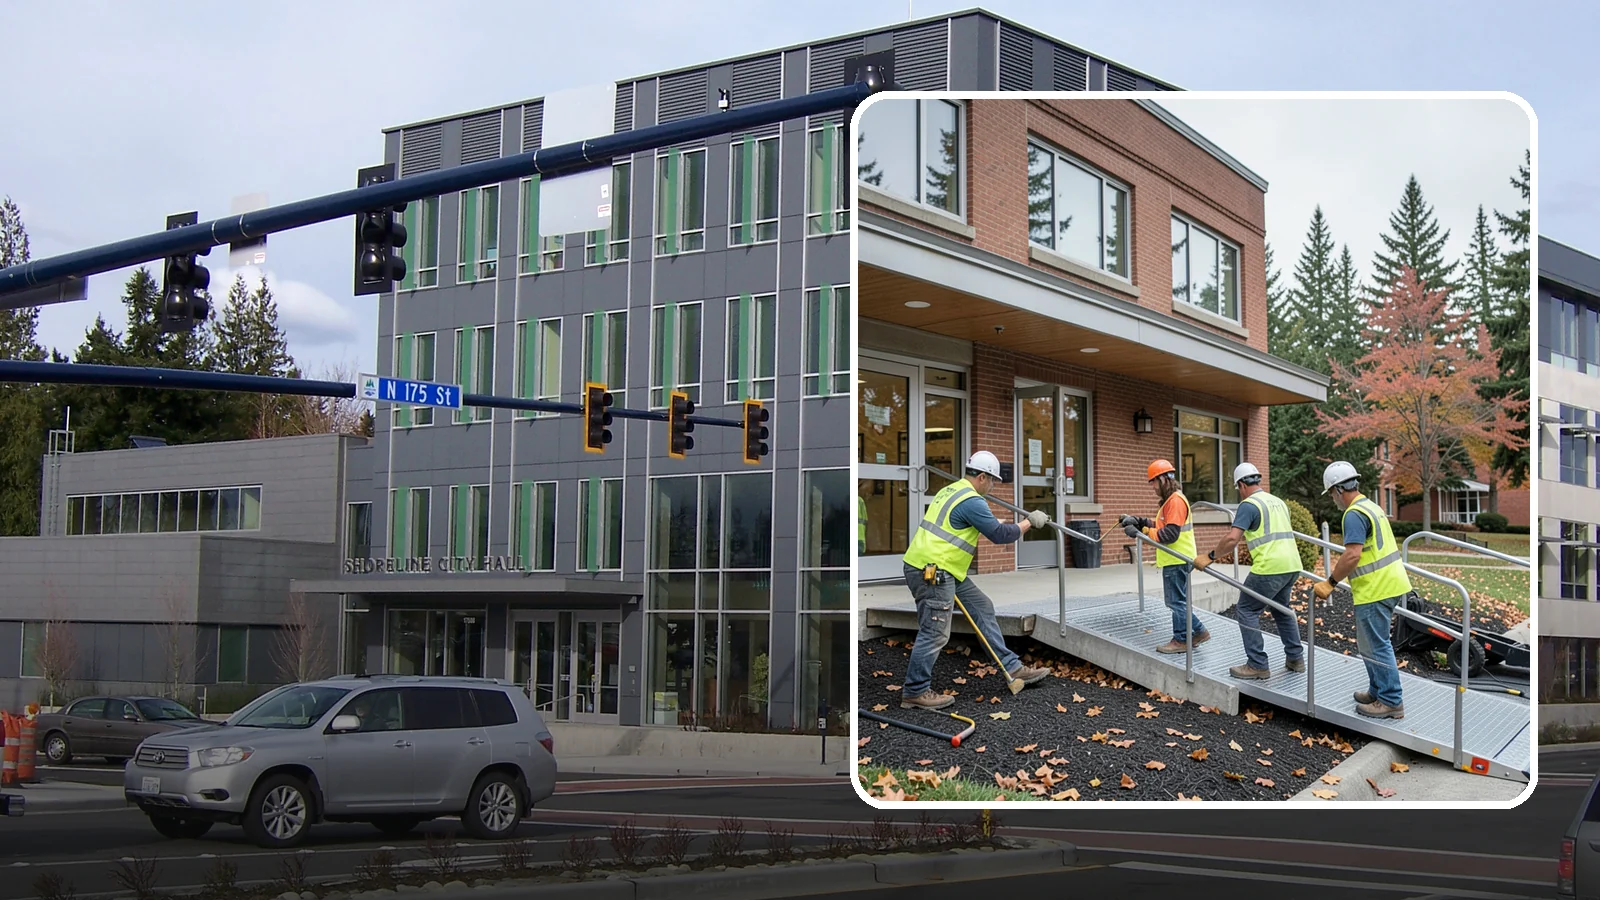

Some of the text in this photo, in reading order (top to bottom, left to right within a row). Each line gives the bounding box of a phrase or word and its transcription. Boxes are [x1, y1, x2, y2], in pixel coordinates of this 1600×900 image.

[387, 380, 451, 406] N 175 St
[343, 555, 525, 574] SHORELINE CITY HALL
